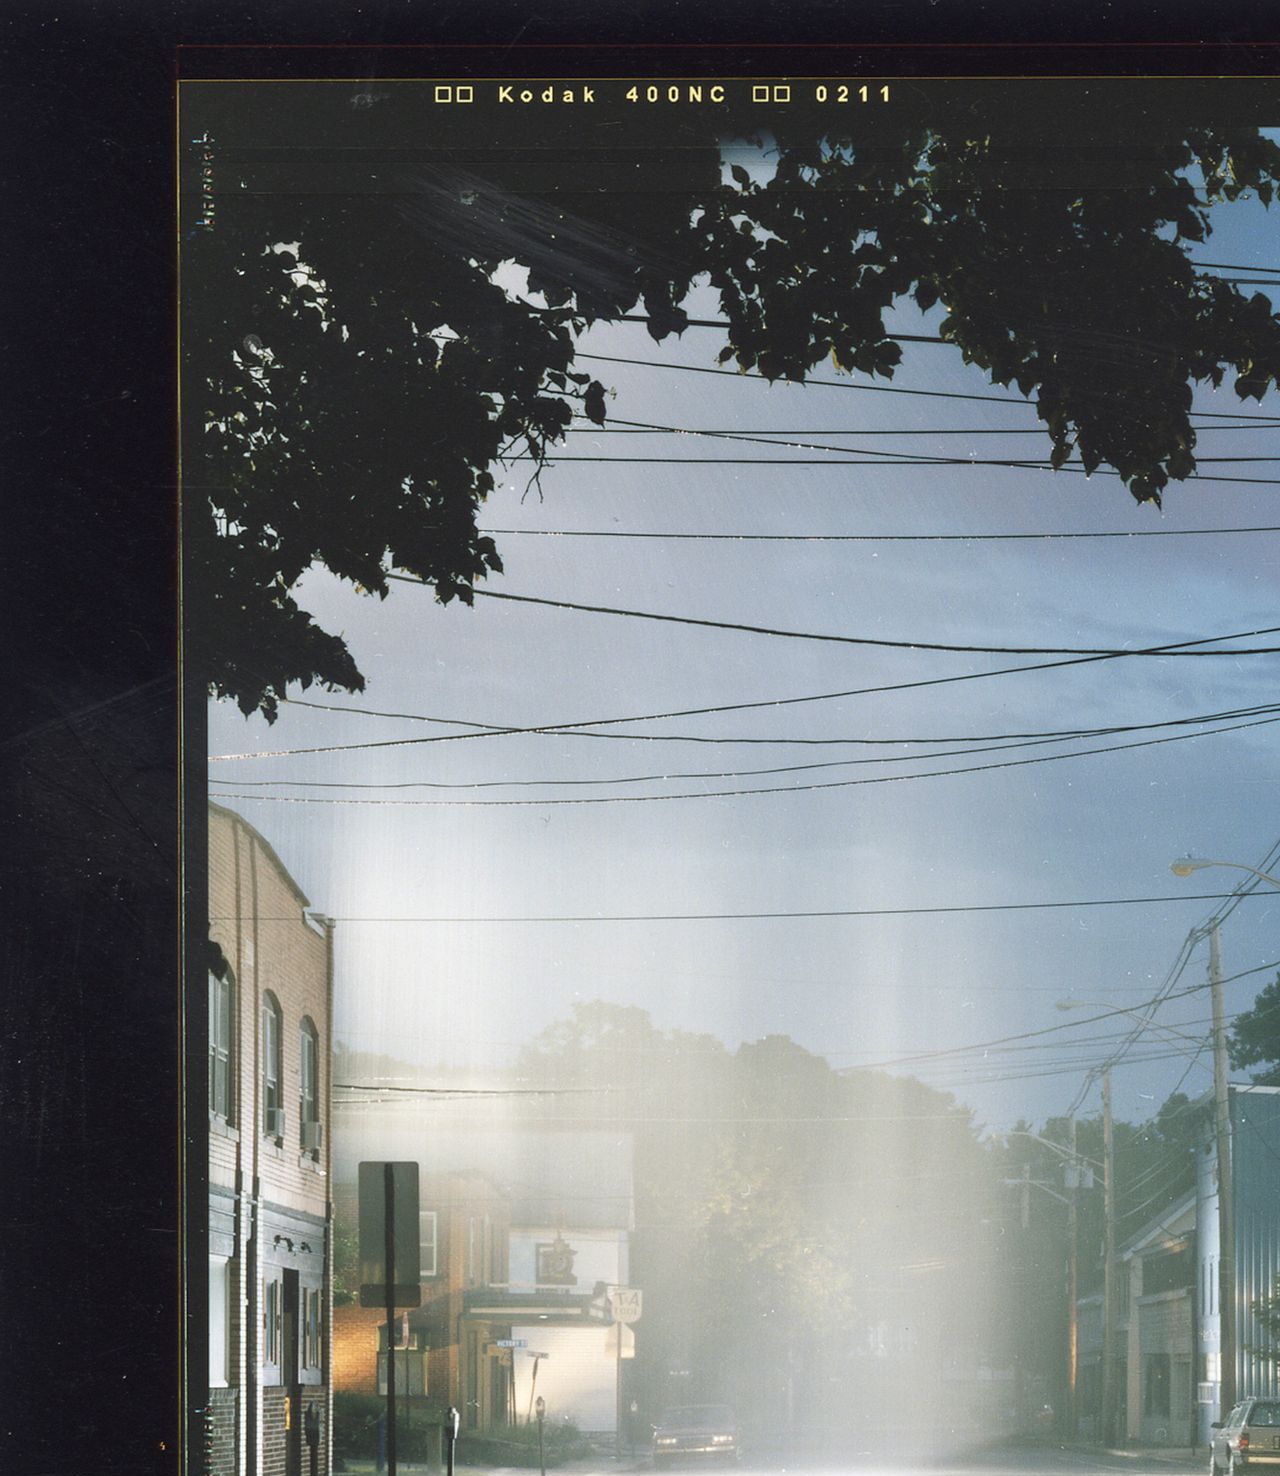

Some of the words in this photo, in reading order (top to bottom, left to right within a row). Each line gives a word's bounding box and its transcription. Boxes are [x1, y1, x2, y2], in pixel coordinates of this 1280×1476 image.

[498, 86, 594, 102] Kodak
[626, 86, 724, 102] 400NC
[816, 86, 890, 102] 0211
